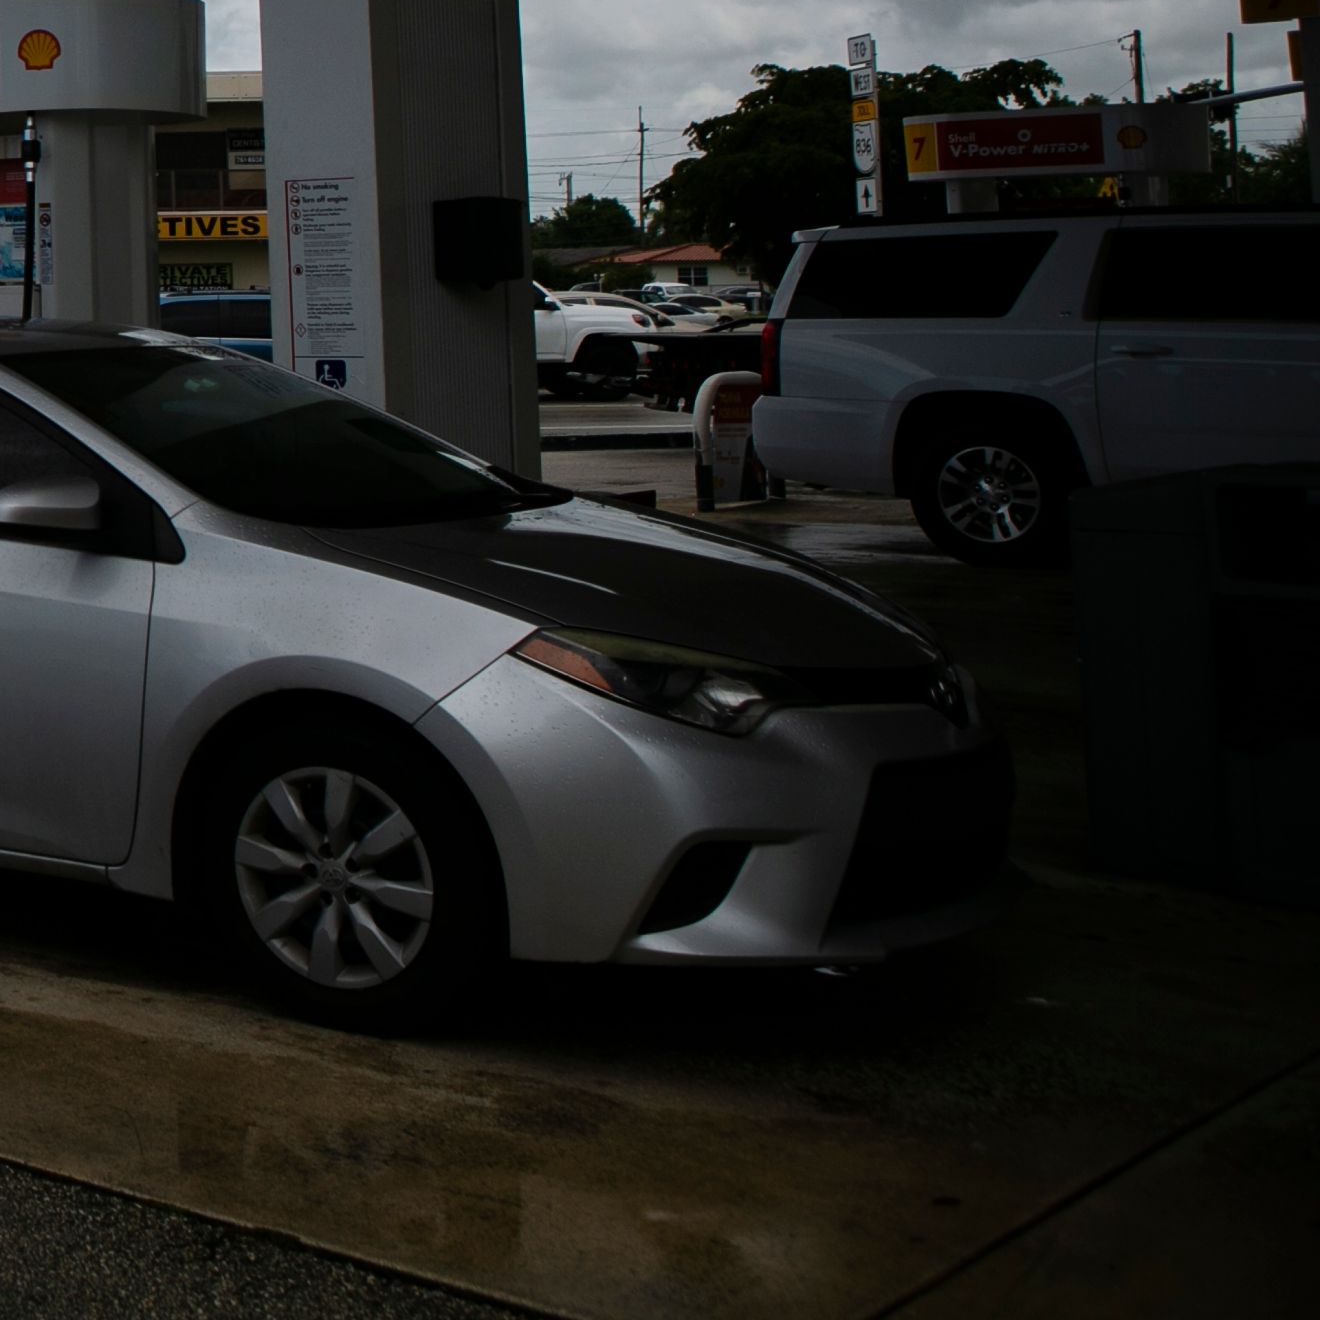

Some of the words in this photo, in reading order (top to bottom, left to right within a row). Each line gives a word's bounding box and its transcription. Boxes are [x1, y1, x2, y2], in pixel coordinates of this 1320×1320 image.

[947, 132, 976, 143] Shell
[912, 136, 926, 160] 7
[949, 143, 1026, 159] V-Power
[157, 216, 260, 236] TIVES
